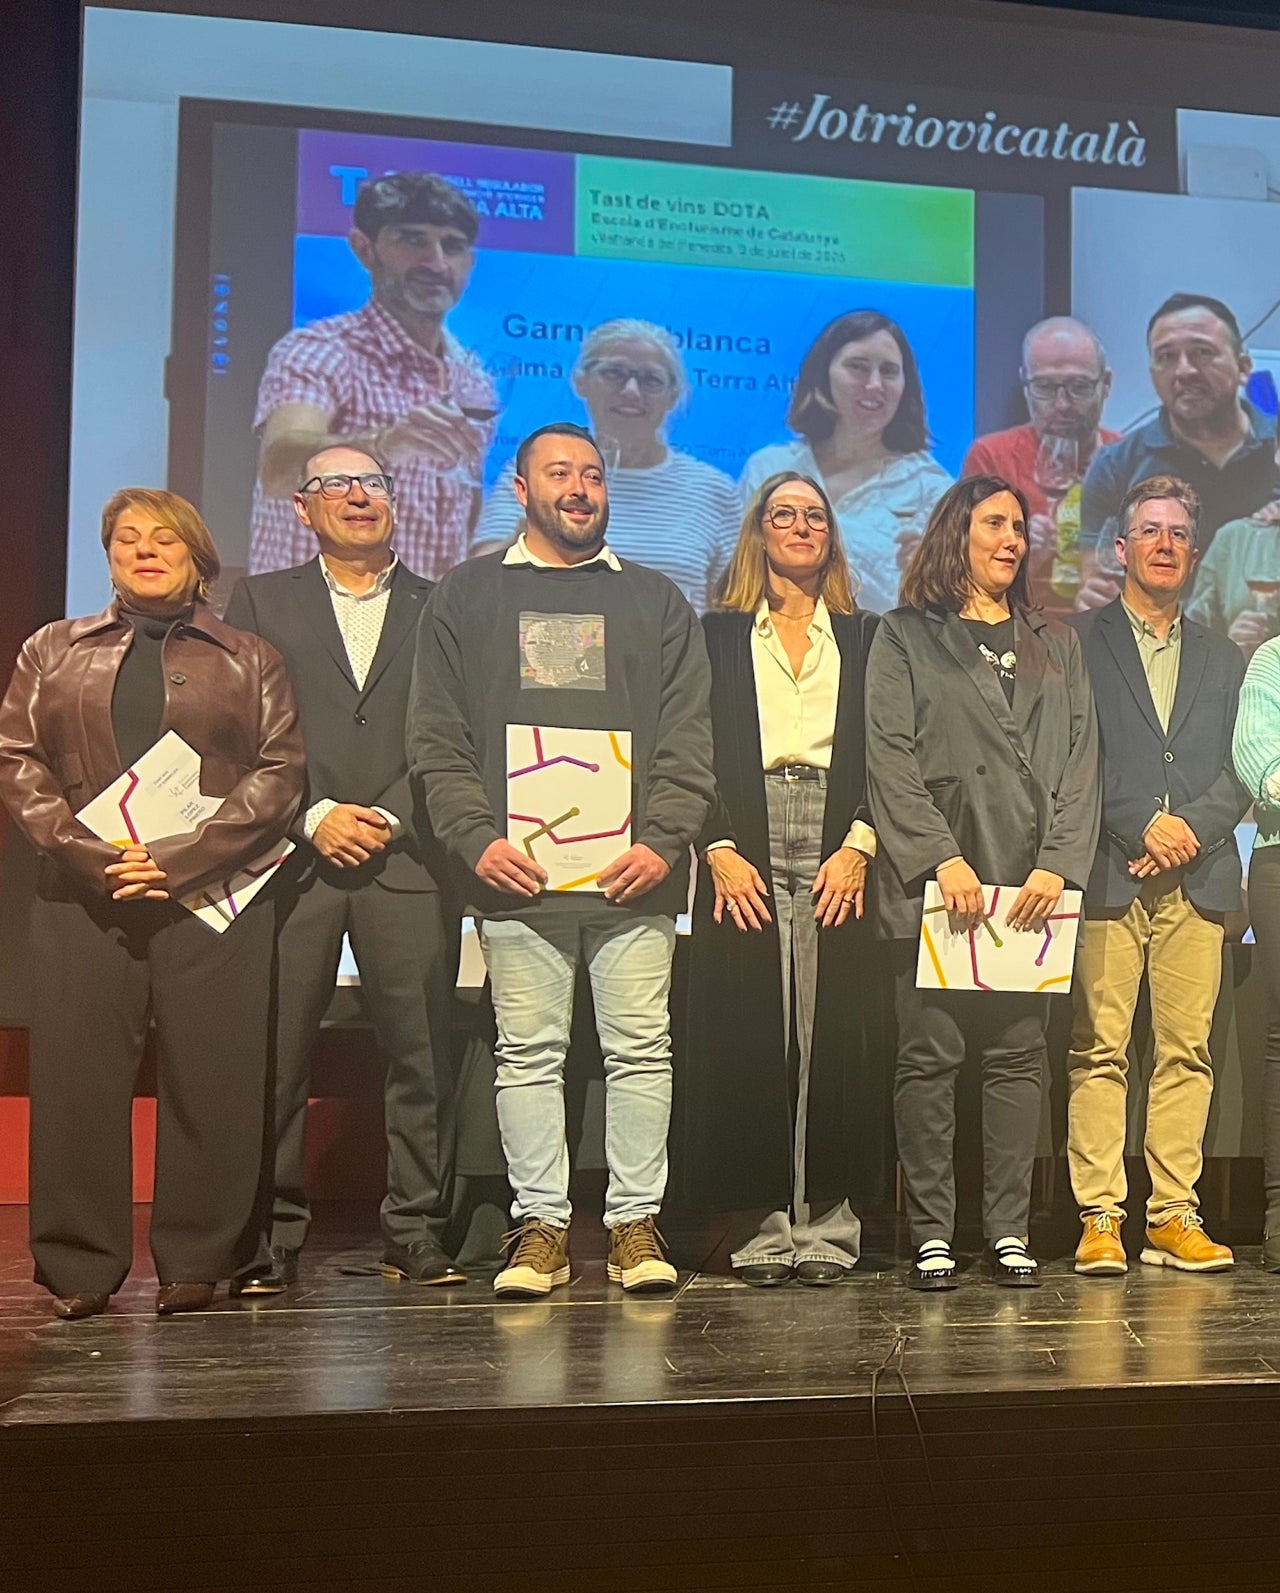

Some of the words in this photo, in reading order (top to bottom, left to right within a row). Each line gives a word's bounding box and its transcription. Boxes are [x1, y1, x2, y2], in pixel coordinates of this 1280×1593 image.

[766, 93, 1147, 168] #Jotriovicatalà
[494, 201, 544, 220] ALTA
[589, 188, 632, 209] Tast
[636, 194, 660, 211] de
[667, 197, 706, 215] vins
[713, 201, 770, 220] DOTA
[502, 313, 586, 343] Garn
[667, 324, 771, 355] blanca
[692, 368, 757, 391] Terra
